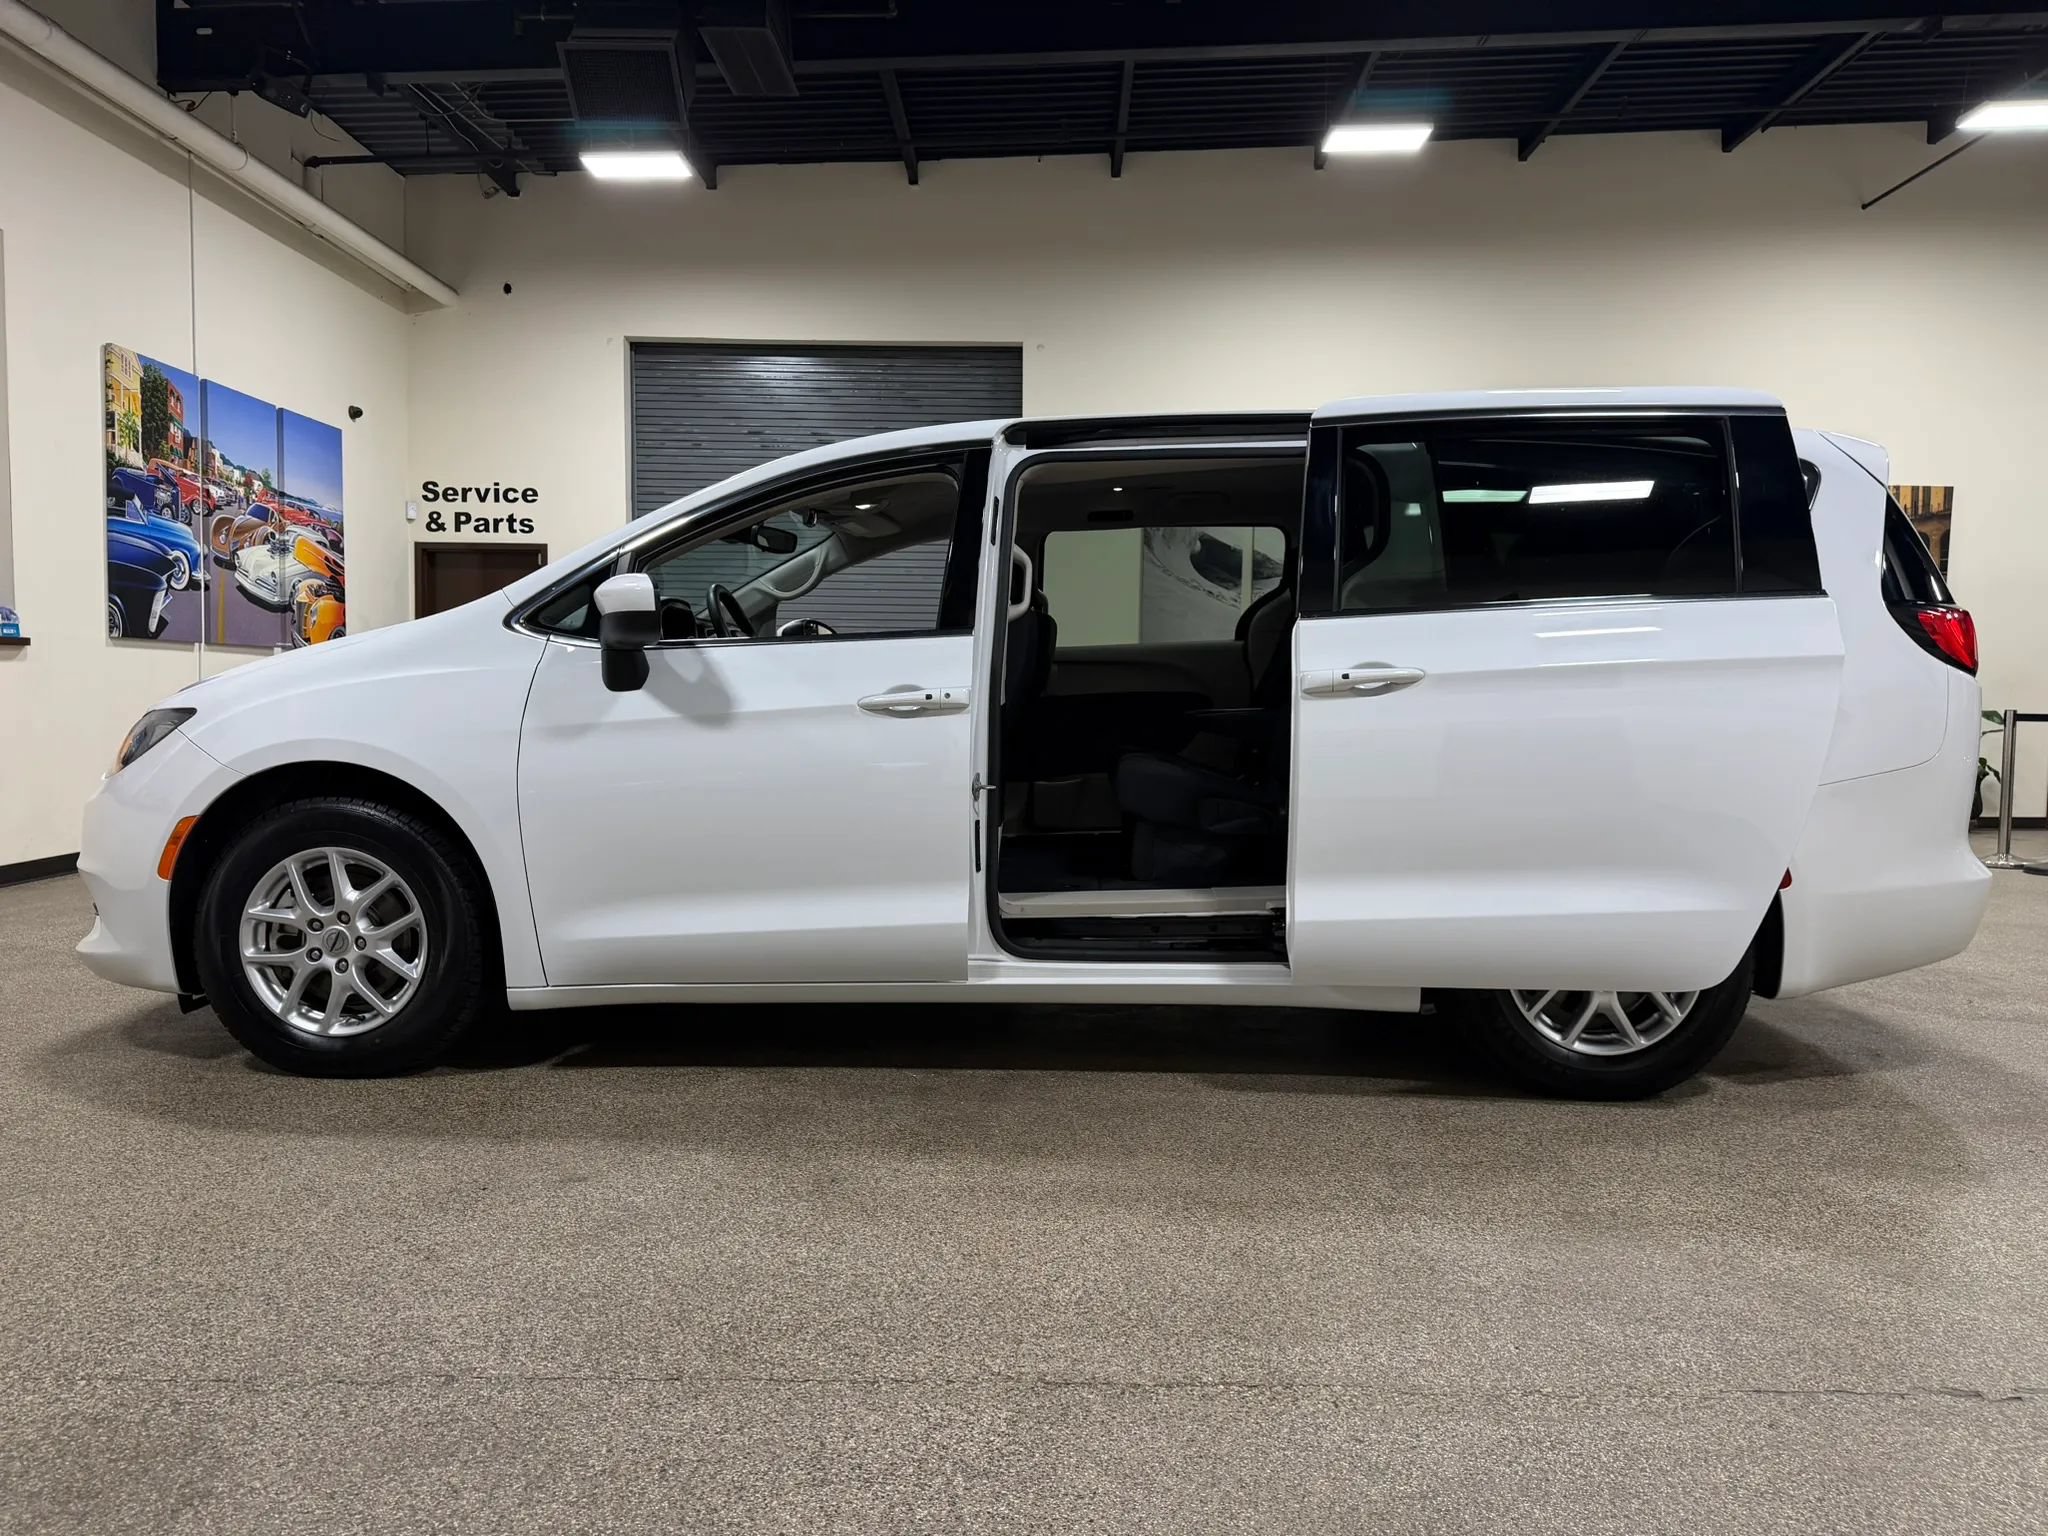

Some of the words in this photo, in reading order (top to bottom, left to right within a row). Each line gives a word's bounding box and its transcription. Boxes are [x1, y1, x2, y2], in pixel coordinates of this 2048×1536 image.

[421, 480, 539, 504] Service
[425, 510, 447, 533] &
[454, 511, 535, 534] Parts
